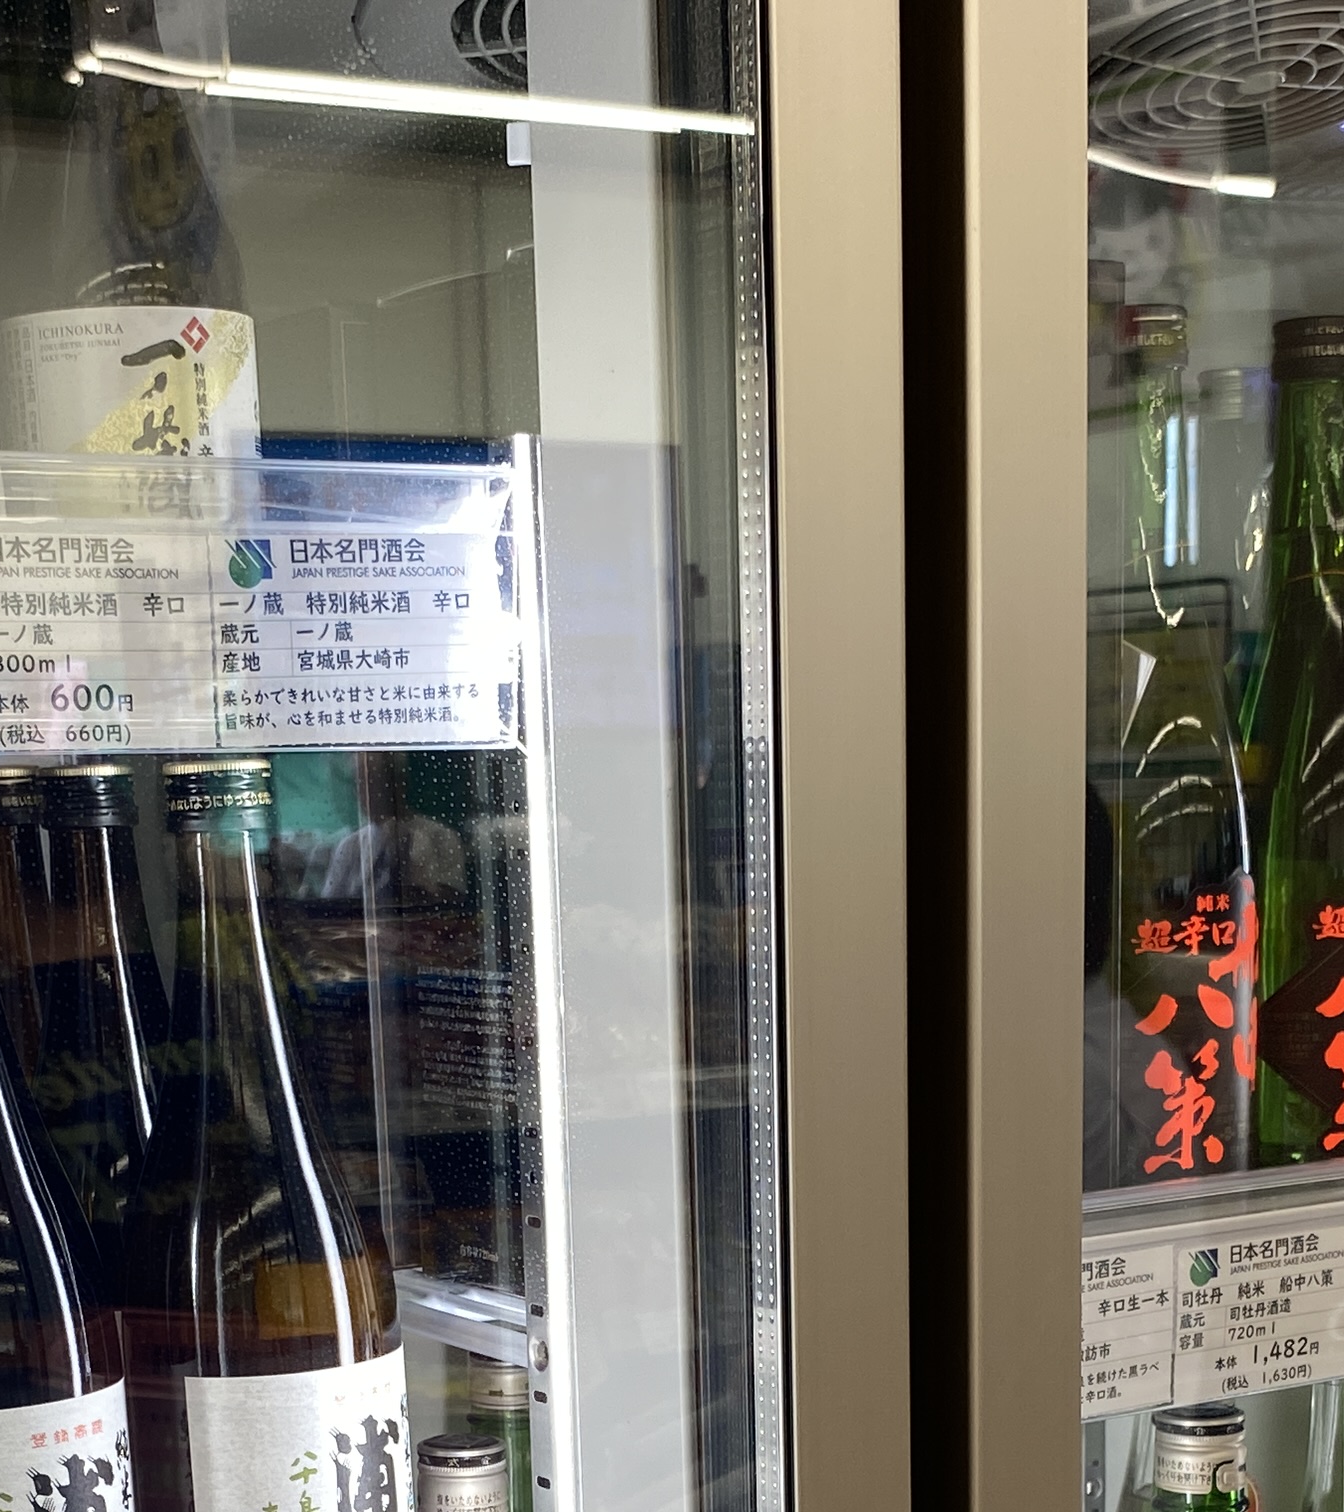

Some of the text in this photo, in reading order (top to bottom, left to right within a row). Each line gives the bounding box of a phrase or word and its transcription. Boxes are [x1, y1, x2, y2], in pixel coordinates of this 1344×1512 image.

[38, 323, 124, 340] ICHINOKURA
[194, 363, 209, 436] 特別純米酒
[290, 538, 425, 564] 日本名門酒会
[23, 568, 71, 578] PRESTIGE
[75, 568, 100, 579] SAKE
[105, 569, 178, 579] ASSOCIATION
[1, 593, 118, 616] 特別純米酒
[143, 593, 185, 616] 辛口
[220, 590, 469, 615] 一ノ蔵 特別純米酒 辛口
[221, 622, 352, 644] 蔵元 一ノ蔵
[222, 649, 410, 673] 産地 宮城県大崎市
[51, 684, 133, 712] 600円
[0, 725, 130, 746] (税込 660円)
[1196, 894, 1230, 913] 純米
[1132, 916, 1236, 957] 超辛口
[1230, 1234, 1319, 1263] 日本名門酒会
[1182, 1269, 1333, 1308] 司牡丹 純米 船中八策
[1180, 1299, 1291, 1330] 蔵元 司牡丹酒造
[1214, 1337, 1319, 1372] 本体 1,482円
[1262, 1365, 1311, 1384] 1,630円)
